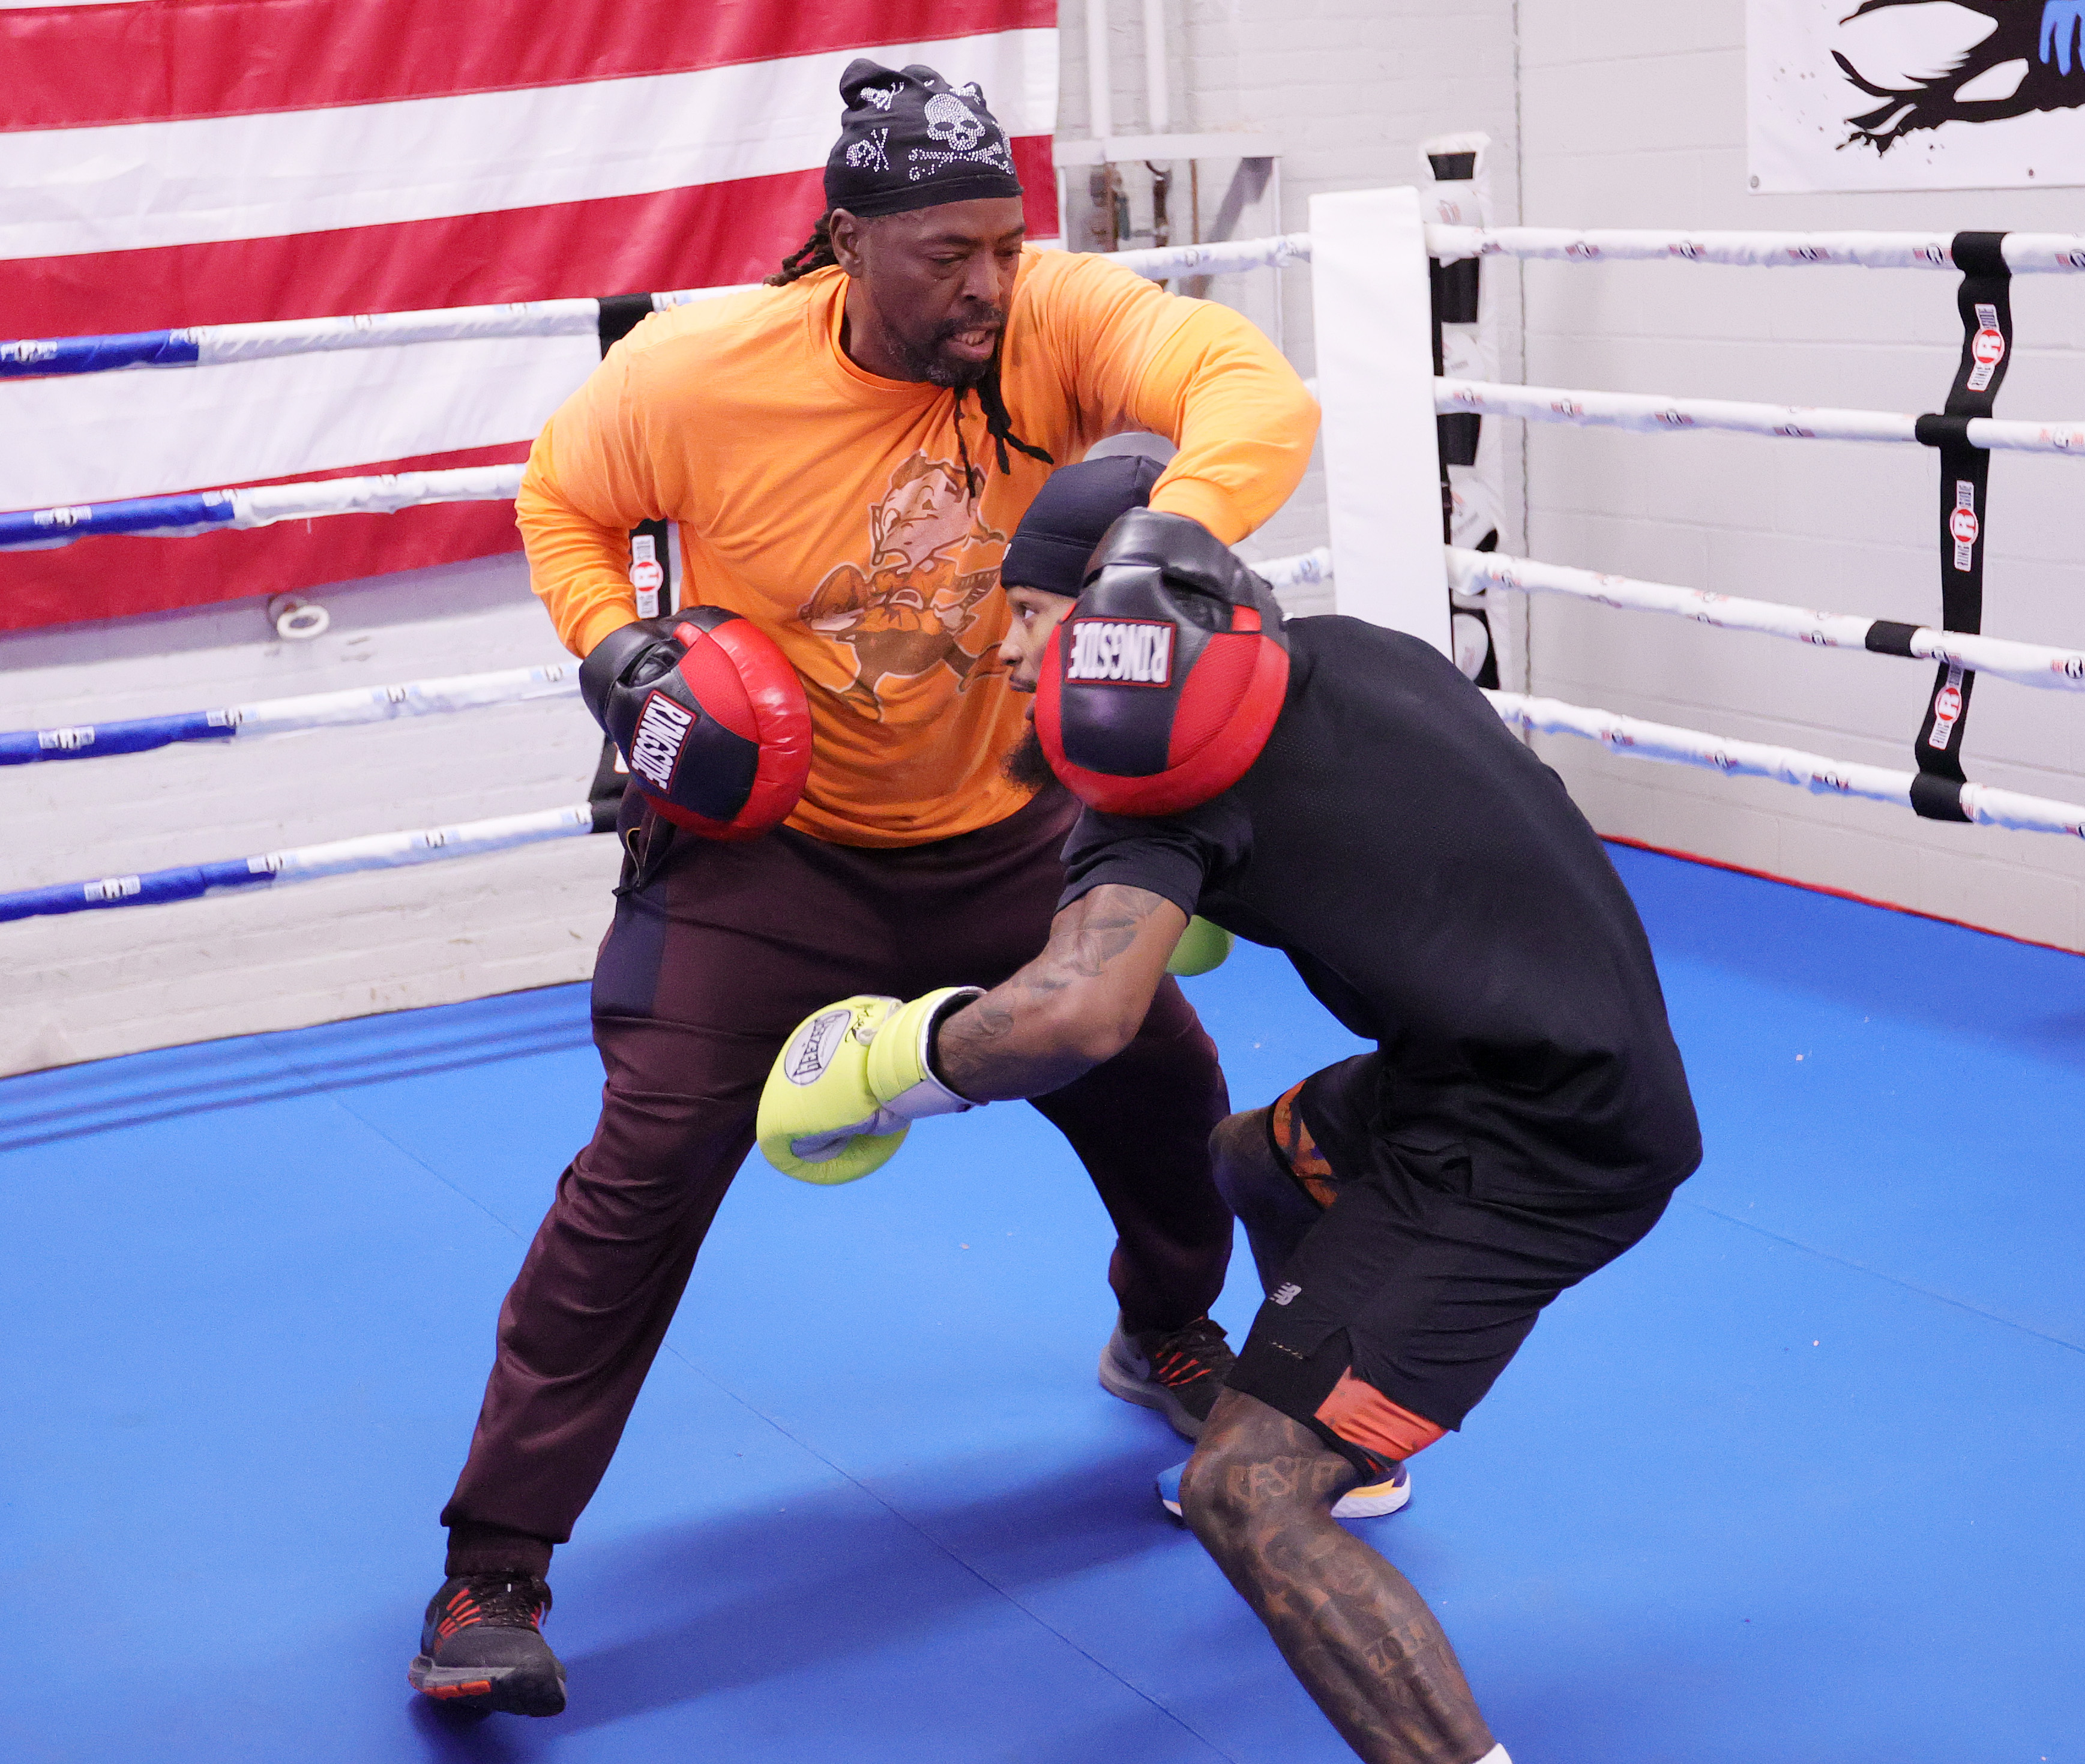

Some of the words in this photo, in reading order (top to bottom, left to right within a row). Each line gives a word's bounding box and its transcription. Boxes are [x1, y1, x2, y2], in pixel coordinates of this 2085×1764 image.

[1976, 334, 2001, 359] R
[1953, 514, 1975, 538] R
[1957, 545, 1969, 567] RING
[634, 567, 658, 587] R
[1068, 622, 1172, 683] RINGSIDE
[1939, 692, 1958, 717] R
[632, 694, 694, 789] RINGSIDE
